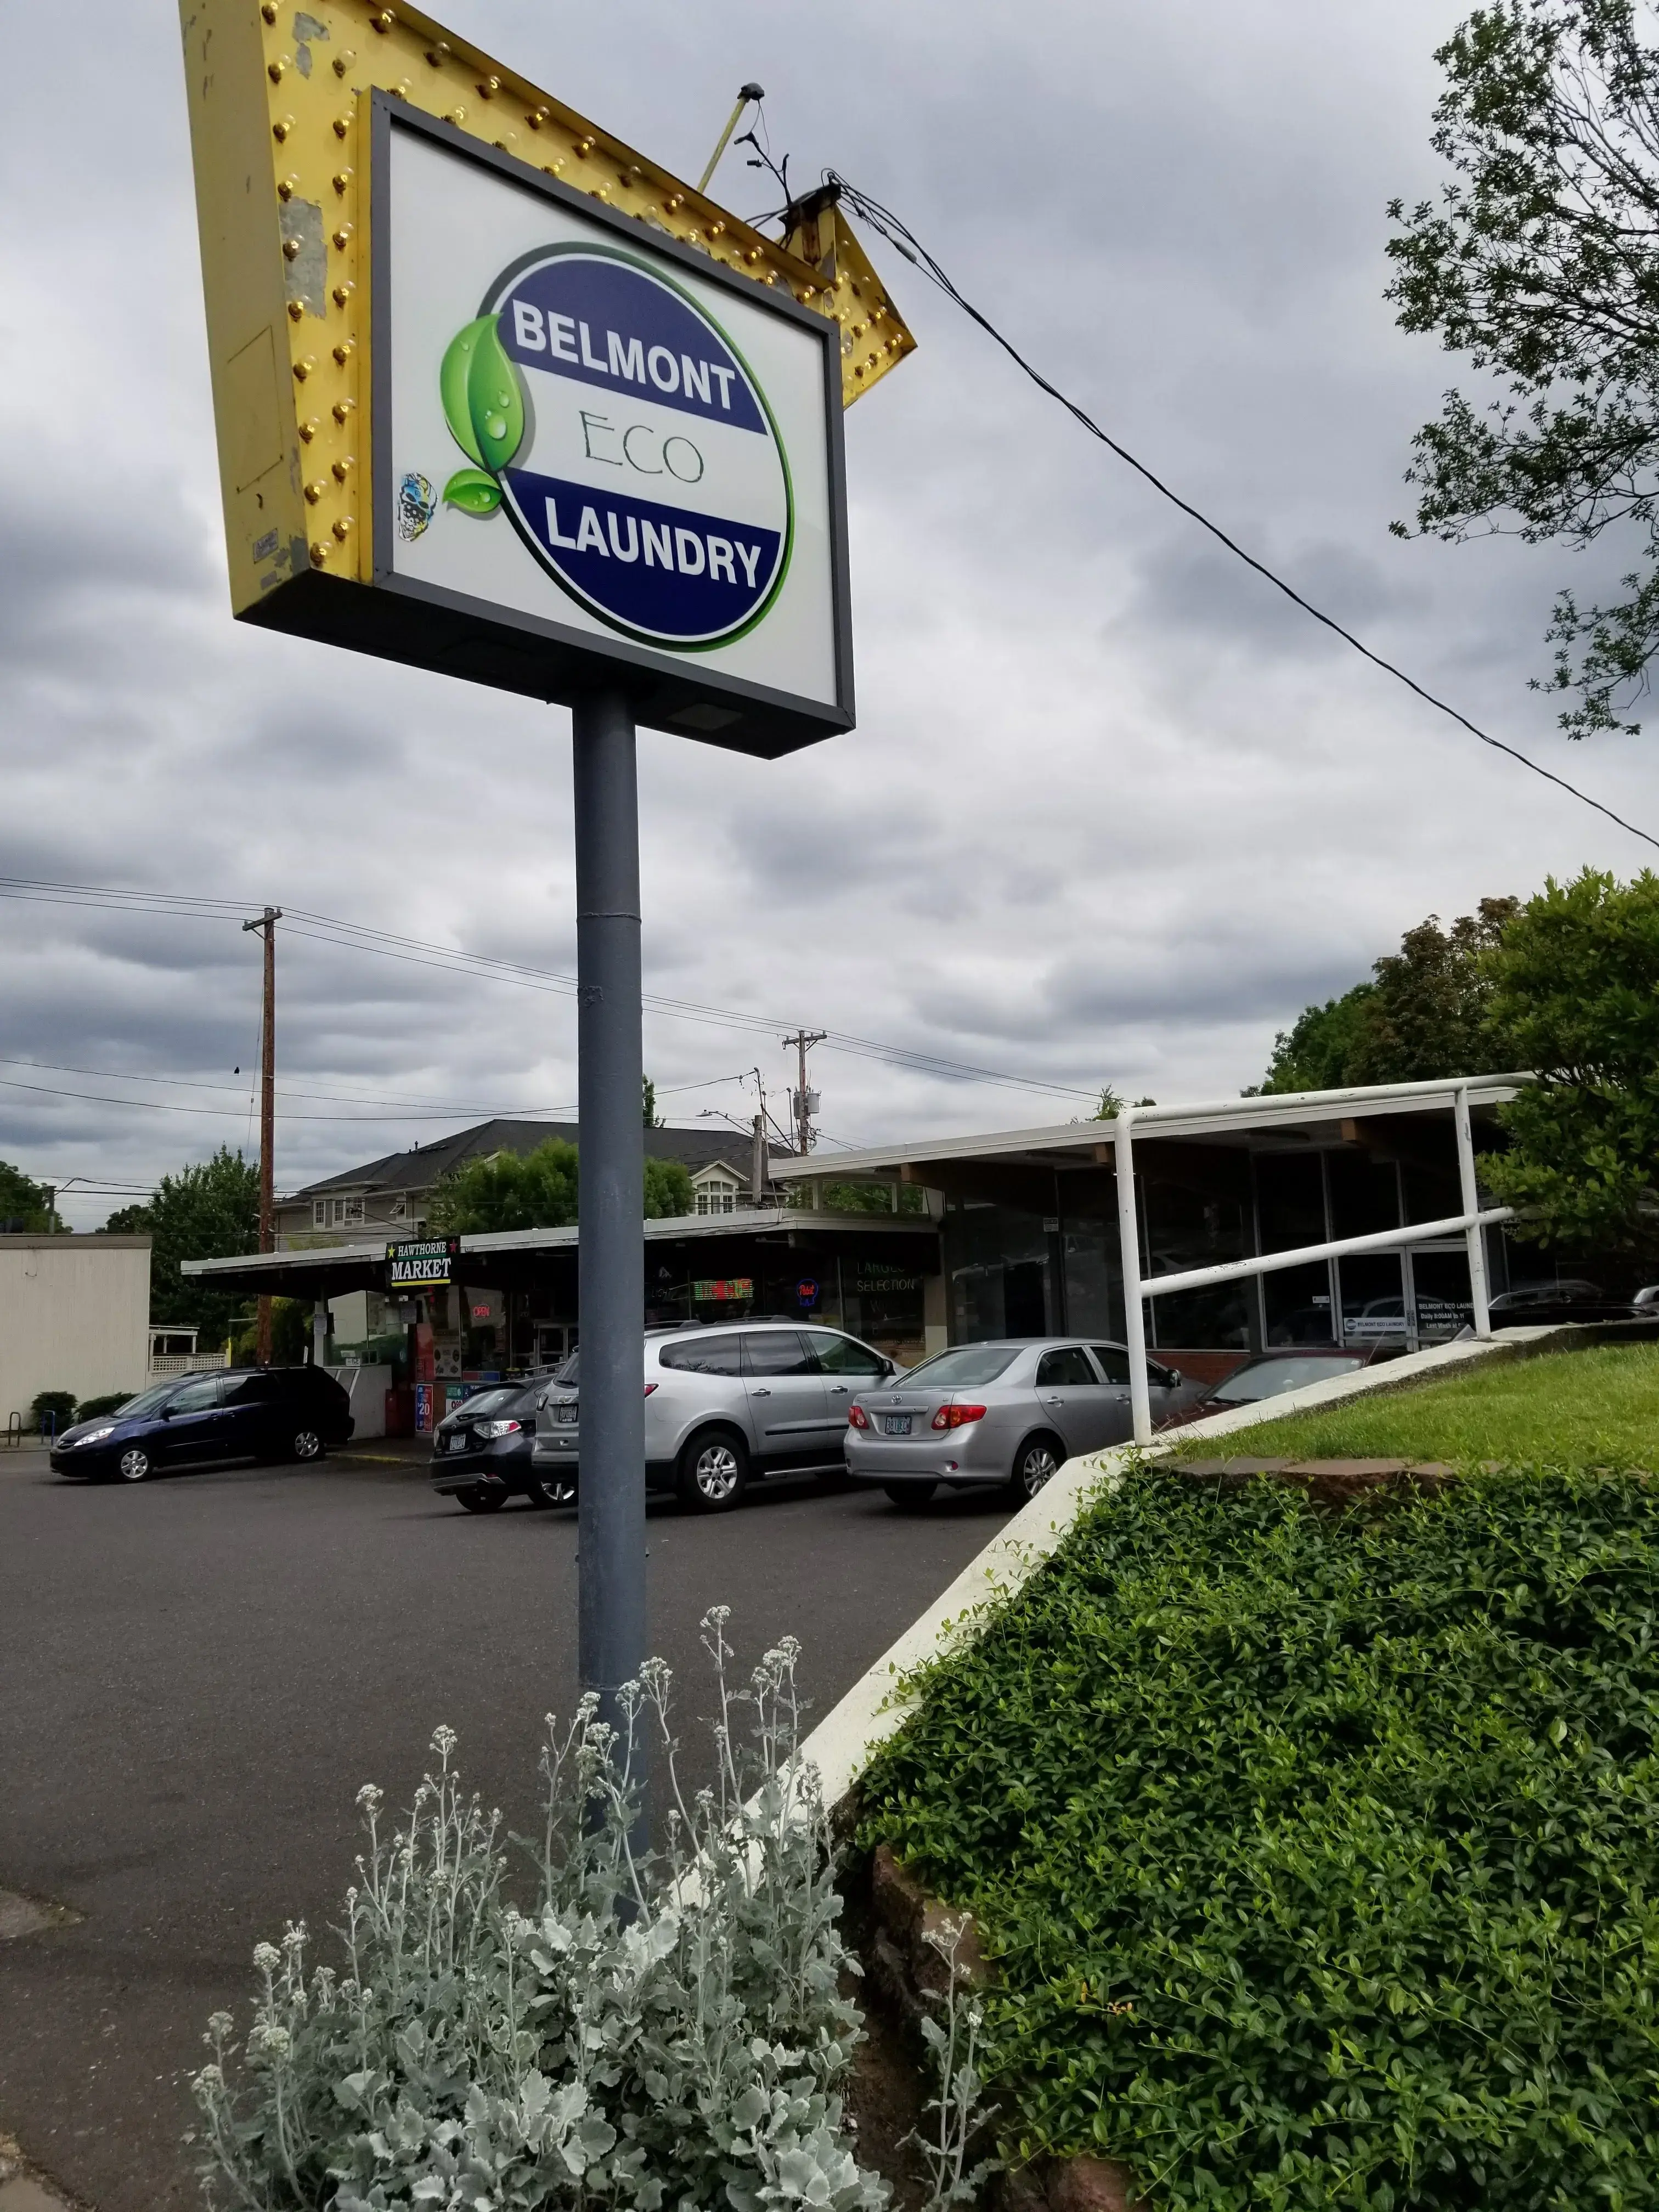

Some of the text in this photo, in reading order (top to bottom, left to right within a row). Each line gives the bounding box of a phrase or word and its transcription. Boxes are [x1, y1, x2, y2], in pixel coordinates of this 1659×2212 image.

[512, 299, 736, 411] BELMONT
[579, 410, 704, 483] ECO
[545, 496, 761, 589] LAUNDRY
[398, 1242, 447, 1256] HAWTHORNE
[392, 1257, 451, 1280] MARKET
[857, 1278, 915, 1292] SELECTION
[473, 1306, 489, 1317] OPEN
